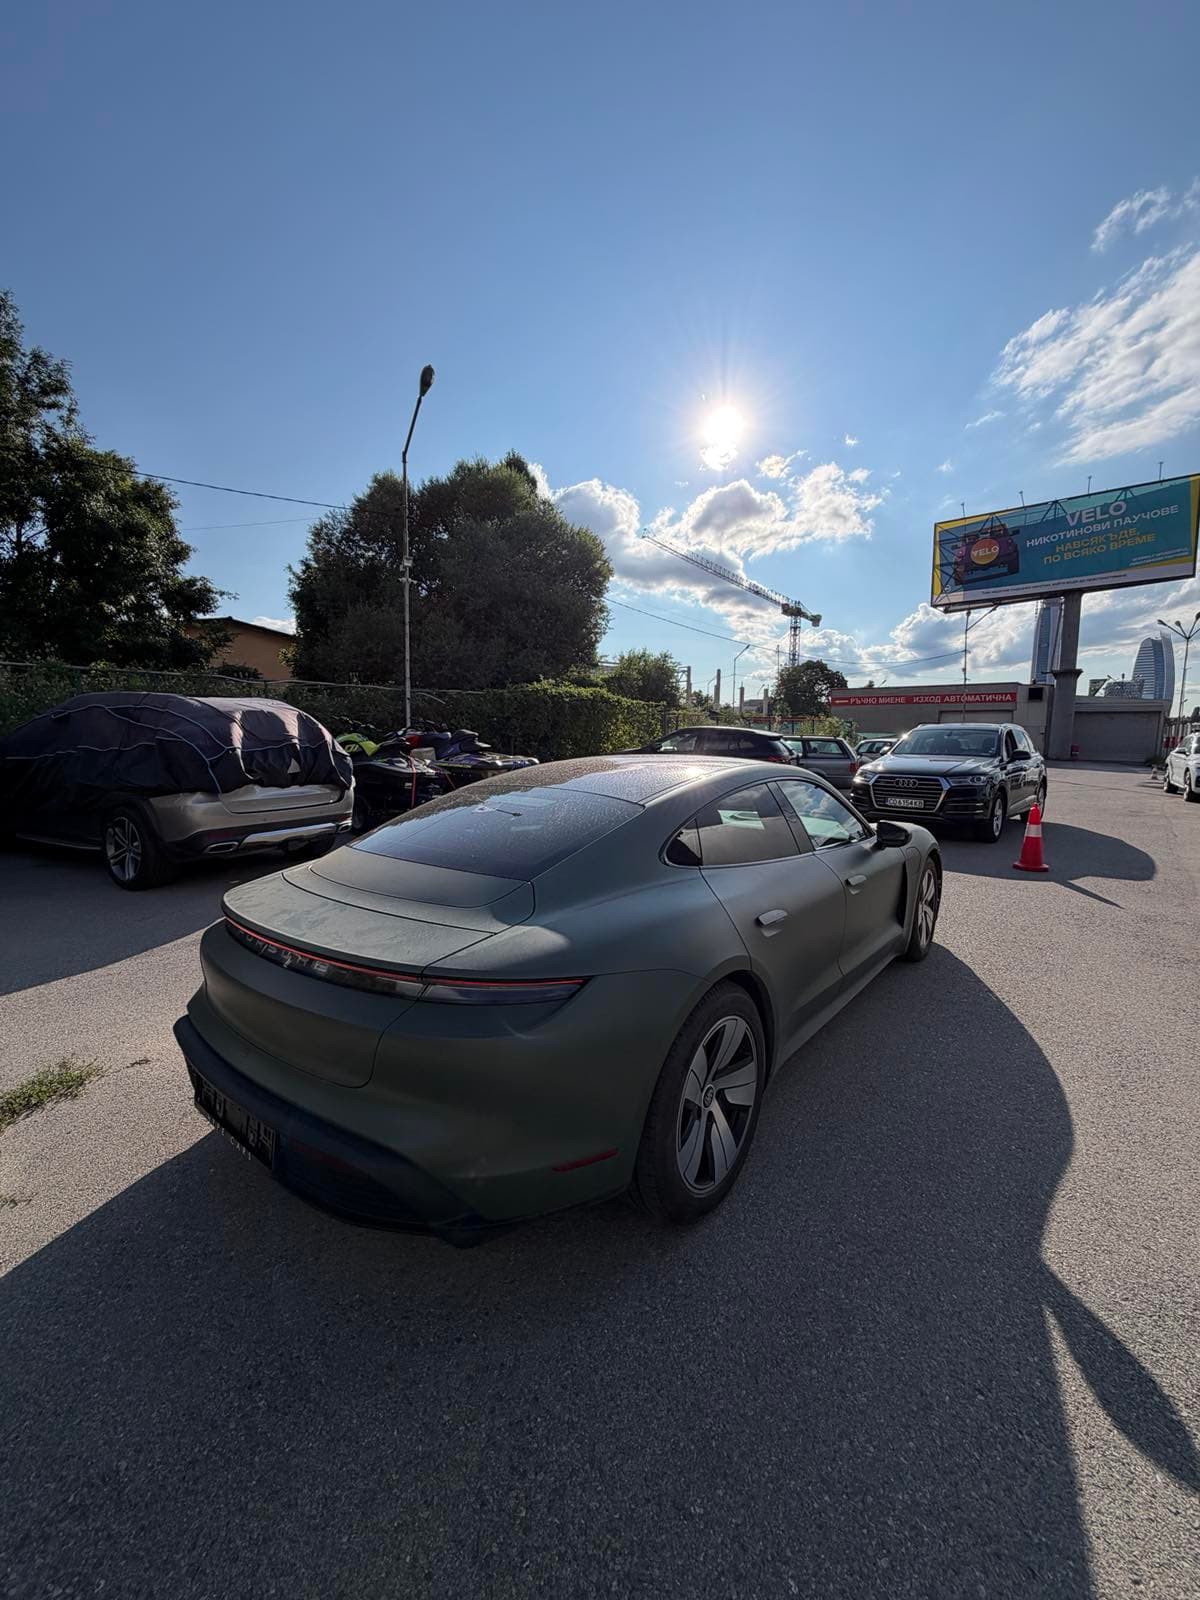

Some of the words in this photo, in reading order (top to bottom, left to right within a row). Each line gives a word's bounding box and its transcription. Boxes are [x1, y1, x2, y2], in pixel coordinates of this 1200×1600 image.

[1026, 520, 1112, 548] НИКОТИНОВИ
[1114, 504, 1180, 528] ПАУЧОВЕ
[1066, 501, 1127, 527] VELO
[972, 544, 1000, 559] VELO
[1043, 549, 1061, 565] ПО
[1063, 543, 1107, 561] ВСЯКО
[1109, 533, 1157, 552] ВРЕМЕ
[850, 696, 877, 705] РЪЧНО
[878, 696, 906, 705] МИЕНЕ
[913, 695, 941, 704] ИЗХОД
[944, 694, 1012, 704] АВТОМАТИЧНА
